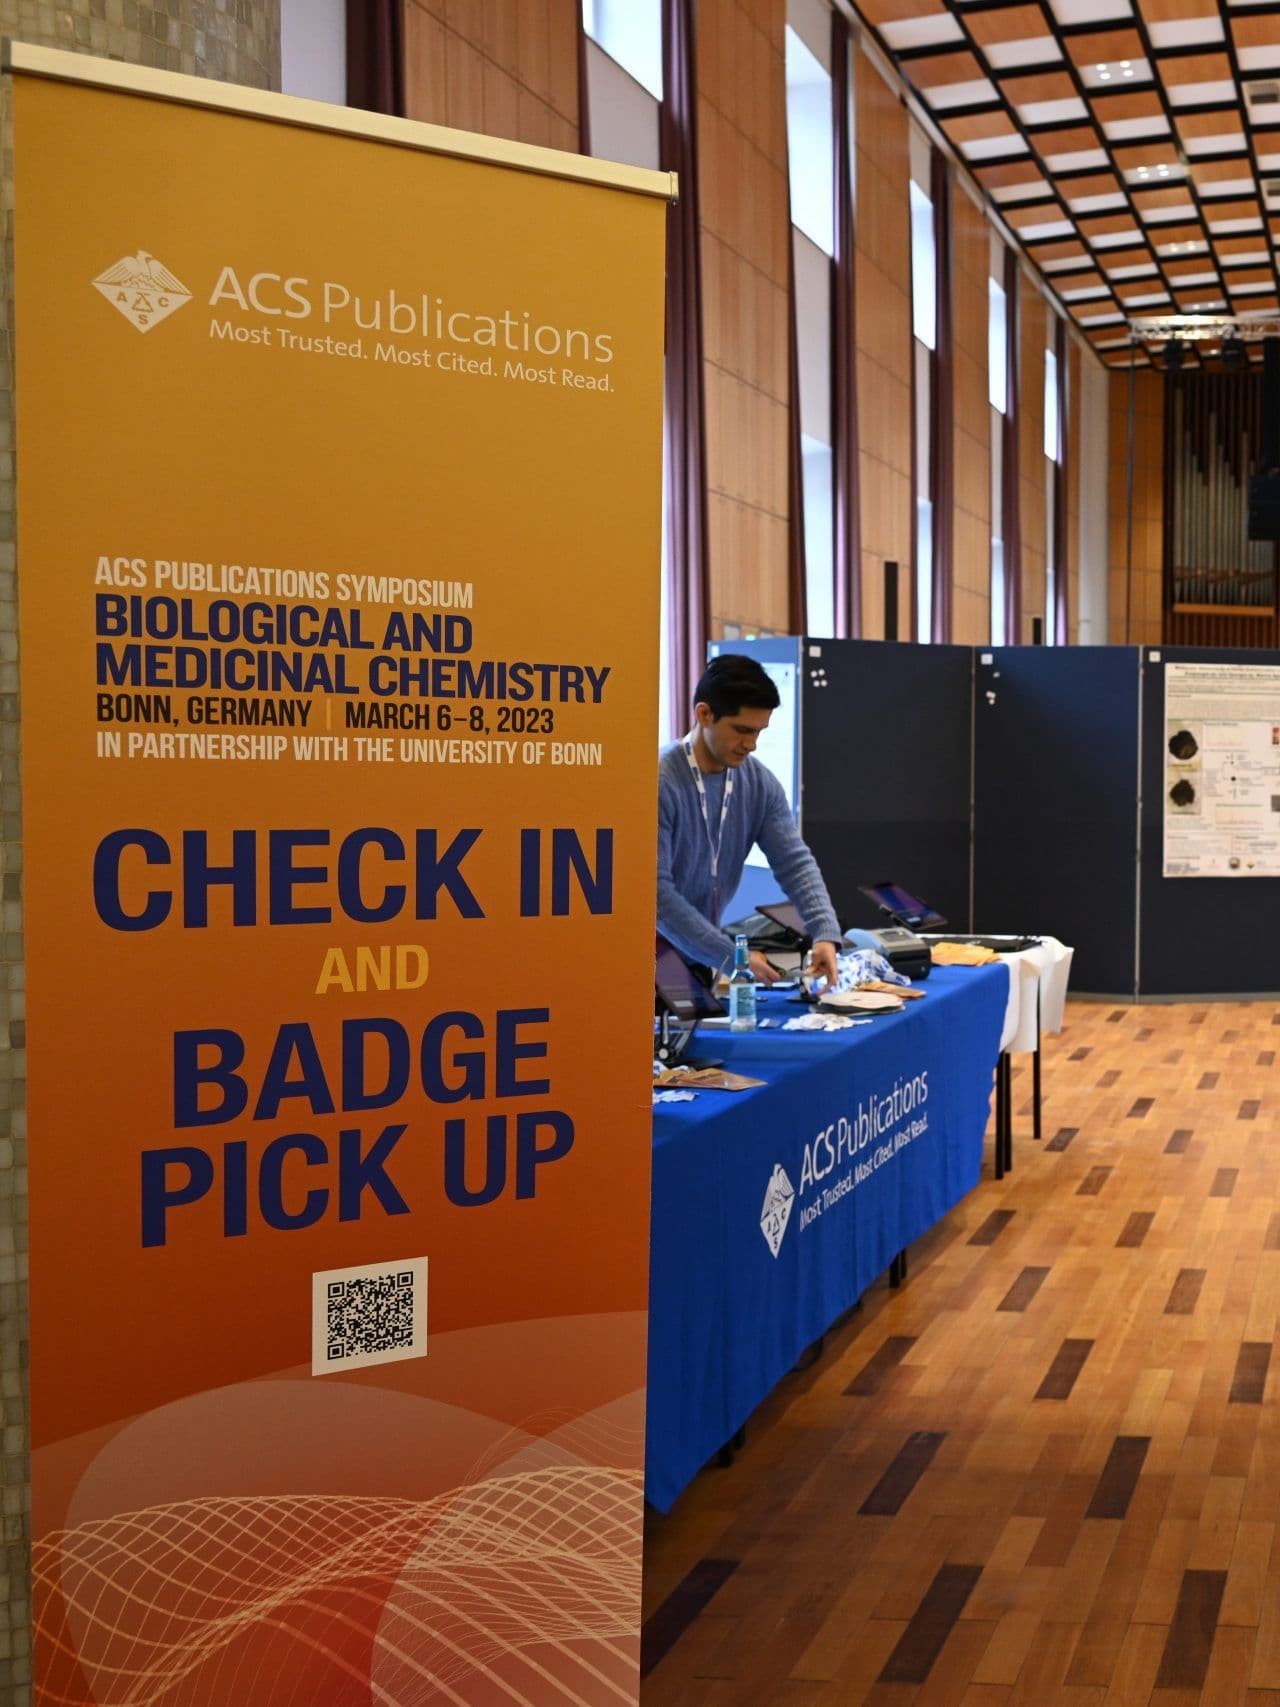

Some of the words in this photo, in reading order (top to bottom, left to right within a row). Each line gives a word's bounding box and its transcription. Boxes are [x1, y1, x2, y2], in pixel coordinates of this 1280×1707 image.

[208, 266, 312, 319] ACS
[323, 282, 614, 364] Publications
[209, 319, 272, 346] Most
[276, 327, 368, 360] Trusted.
[374, 342, 432, 369] Most
[437, 351, 498, 377] Cited.
[503, 360, 557, 385] Most
[562, 368, 615, 393] Read.
[94, 556, 148, 588] ACS
[154, 559, 330, 600] PUBLICATIONS
[335, 573, 473, 609] SYMPOSIUM
[95, 592, 375, 650] BIOLOGICAL
[381, 611, 473, 654] AND
[96, 642, 360, 694] MEDICINAL
[368, 655, 612, 704] CHEMISTRY
[96, 693, 180, 727] BONN,
[187, 696, 312, 727] GERMANY
[345, 701, 430, 730] MARCH
[497, 707, 554, 733] 2023
[96, 731, 121, 758] IN
[128, 731, 288, 760] PARTNERSHIP
[292, 735, 348, 761] WITH
[353, 737, 394, 762] THE
[400, 738, 517, 765] UNIVERSITY
[522, 741, 546, 765] OF
[551, 742, 602, 765] BONN
[92, 826, 486, 932] CHECK
[518, 828, 613, 917] IN
[315, 944, 430, 994] AND
[172, 1007, 550, 1129] BADGE
[799, 1124, 834, 1196] ACS
[837, 1070, 928, 1165] Publications
[140, 1124, 410, 1249] PICK
[443, 1110, 575, 1208] UP
[800, 1196, 822, 1233] Most
[855, 1156, 873, 1185] Most
